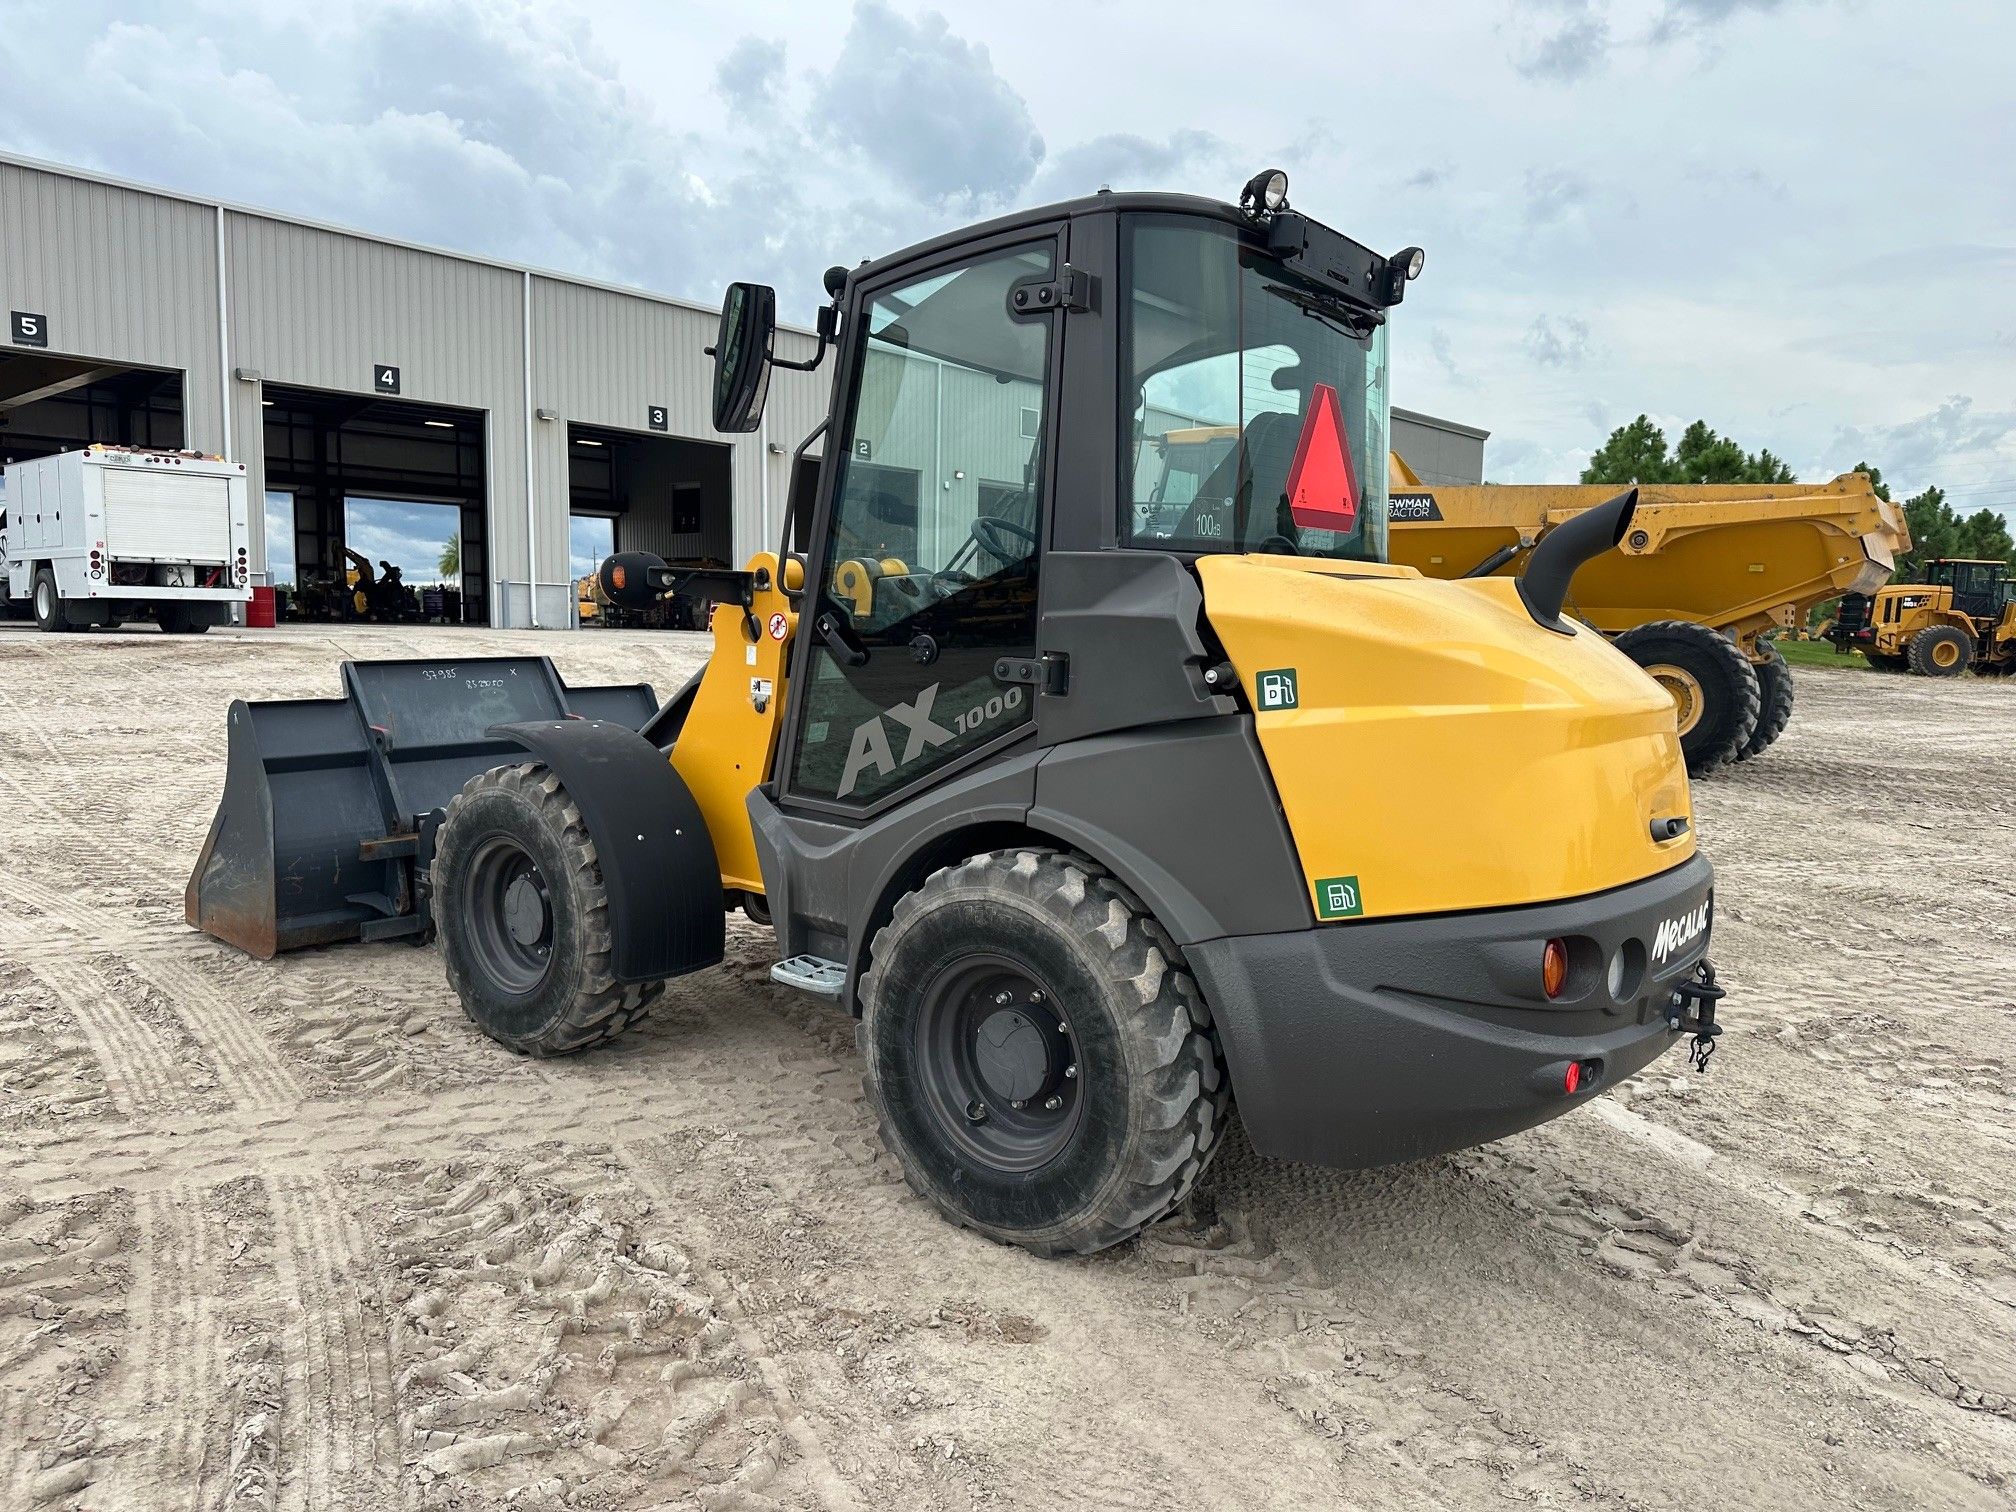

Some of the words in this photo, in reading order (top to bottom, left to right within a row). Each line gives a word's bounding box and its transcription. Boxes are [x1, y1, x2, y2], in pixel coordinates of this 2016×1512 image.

[21, 316, 38, 336] 5
[381, 369, 394, 386] 4
[653, 409, 663, 423] 3
[860, 442, 868, 454] 2
[1389, 498, 1431, 509] EWMAN
[1389, 507, 1430, 518] RACTOR
[1269, 689, 1278, 699] D
[836, 681, 958, 800] AX
[954, 686, 1023, 735] 1000
[1333, 897, 1342, 907] D
